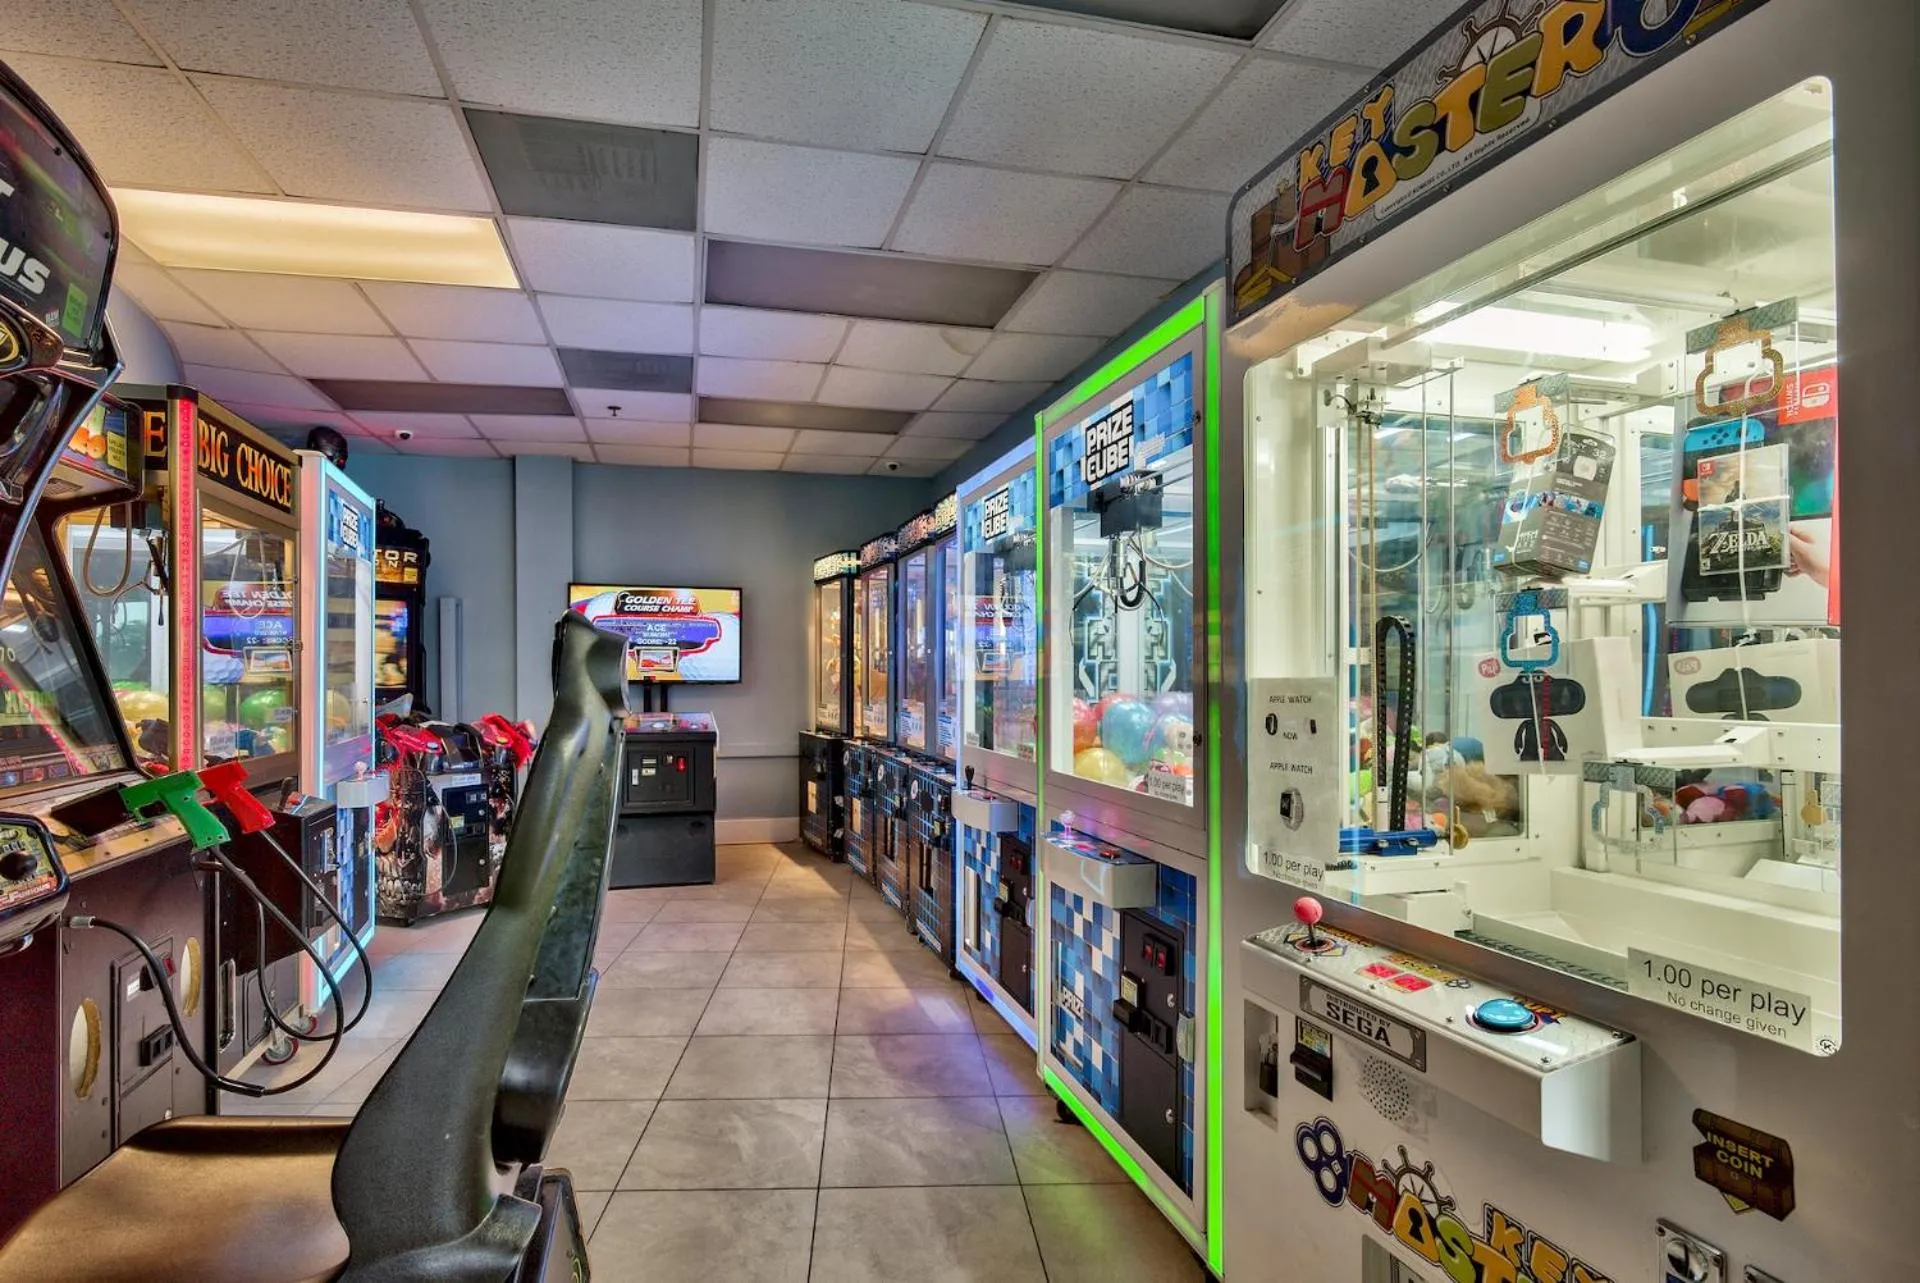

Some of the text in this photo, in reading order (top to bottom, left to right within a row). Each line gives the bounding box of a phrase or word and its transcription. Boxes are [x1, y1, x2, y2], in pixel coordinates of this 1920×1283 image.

[1300, 85, 1395, 184] KEY
[1087, 404, 1133, 457] PRIZE
[198, 418, 230, 478] BIG
[236, 442, 292, 508] CHOICE
[1086, 437, 1131, 484] CUBE
[984, 490, 1009, 517] PRIZE
[984, 511, 1007, 538] CUBE
[624, 604, 660, 612] COURSE
[625, 595, 673, 604] GOLDEN
[646, 623, 667, 632] ACE
[1288, 695, 1312, 704] WATCH
[1643, 958, 1807, 1026] 1.00 per play
[1326, 1001, 1391, 1047] SEGA
[1666, 990, 1787, 1040] No change given
[1706, 1131, 1775, 1168] INSERT
[1716, 1150, 1763, 1179] COIN
